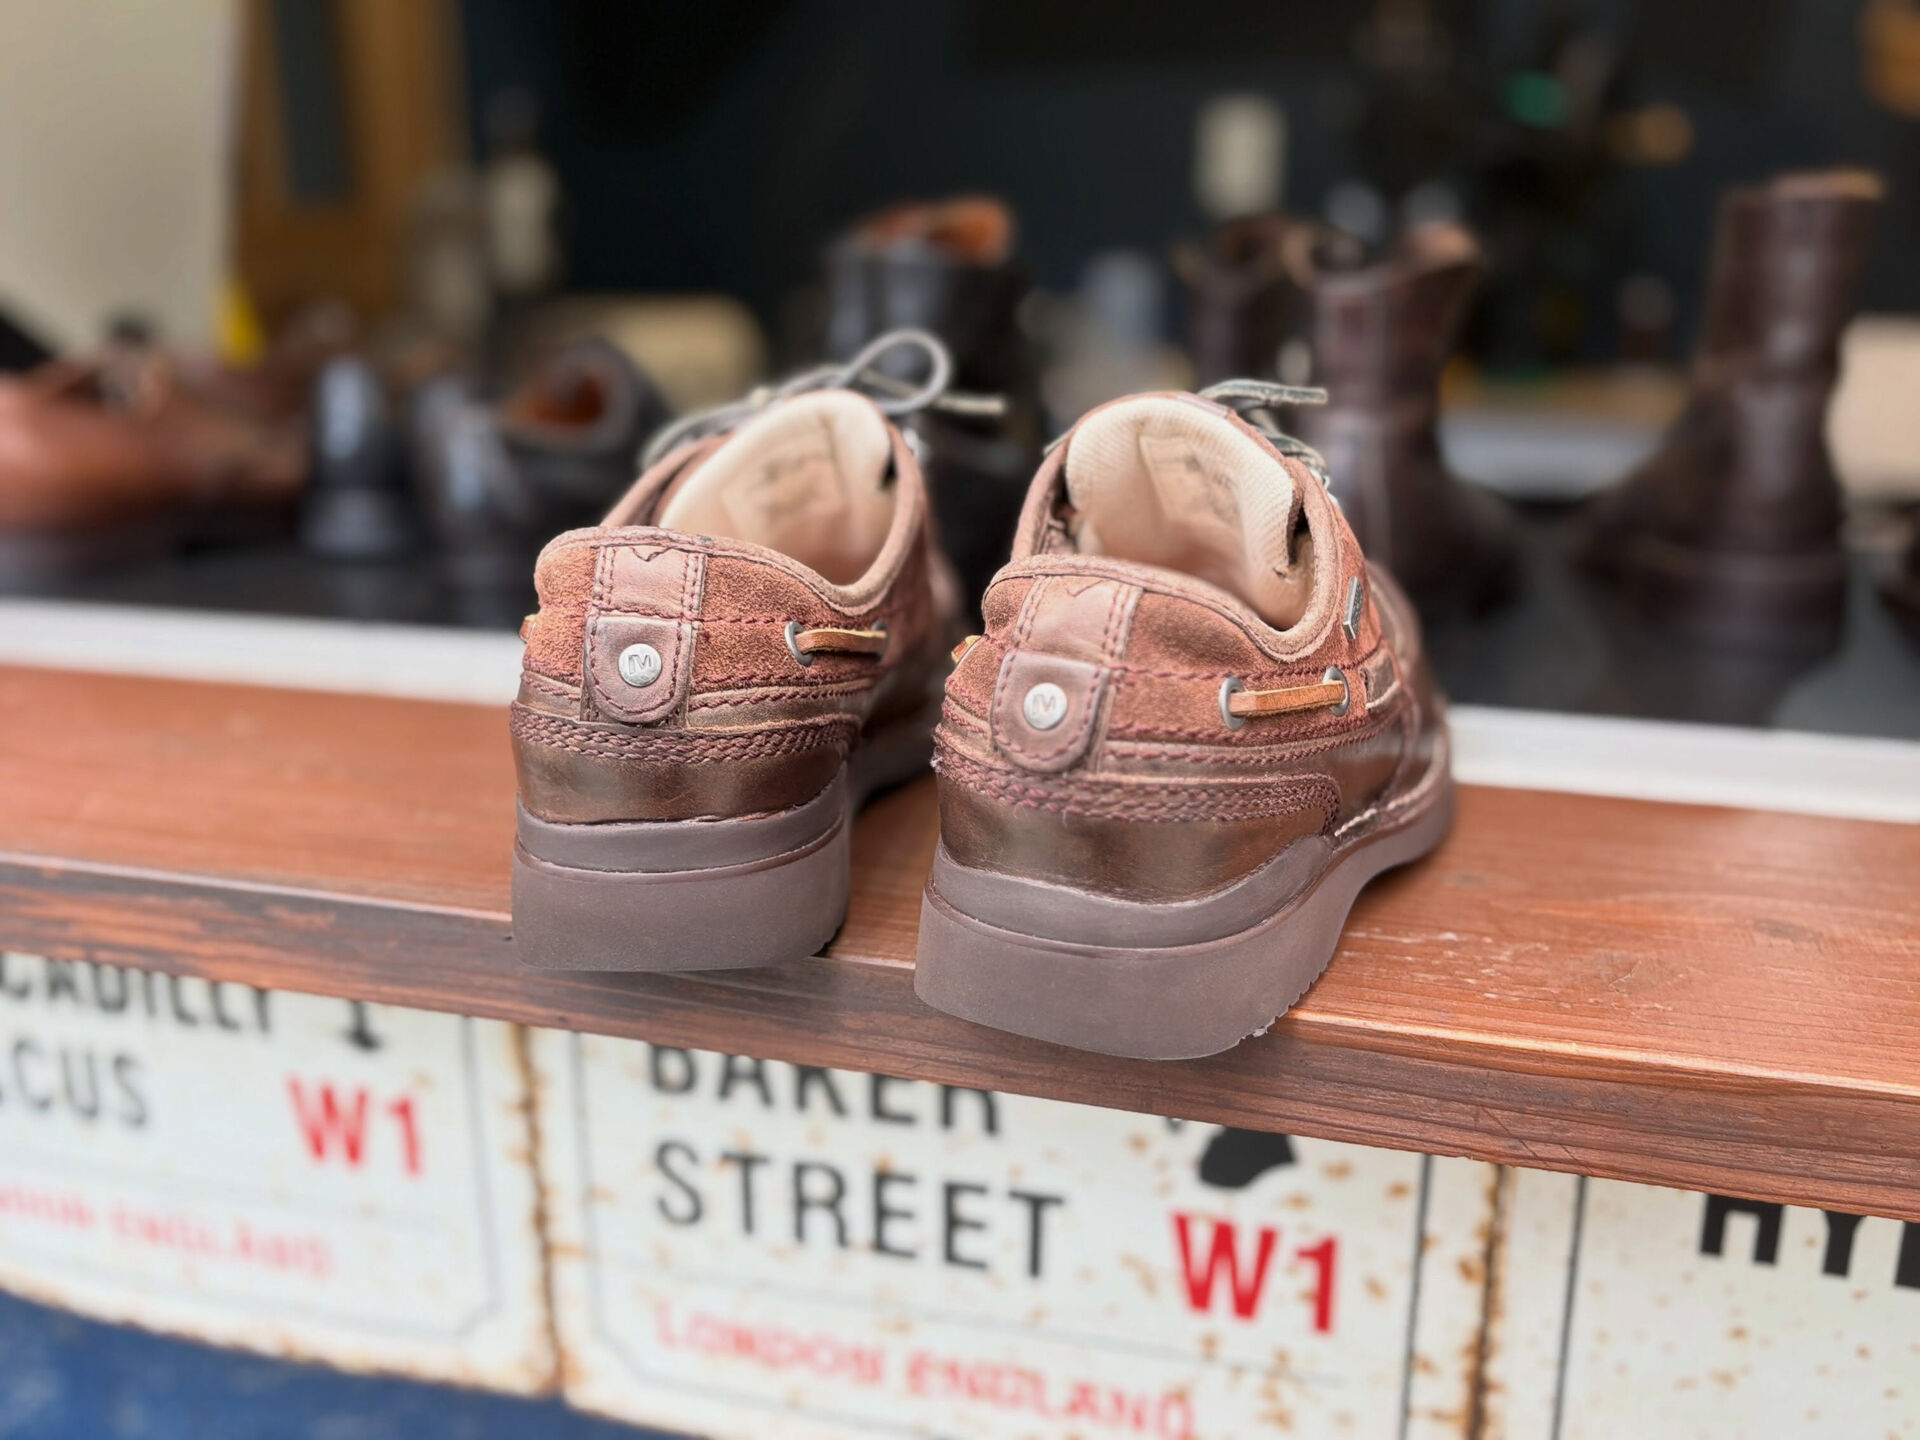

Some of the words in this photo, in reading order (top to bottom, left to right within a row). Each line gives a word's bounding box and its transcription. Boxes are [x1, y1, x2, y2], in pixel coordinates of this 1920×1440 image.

[0, 1038, 148, 1127] CUS
[286, 1071, 421, 1178] W1
[654, 1140, 1066, 1280] STREET
[1698, 1193, 1920, 1290] HY
[1172, 1209, 1340, 1336] W1
[652, 1300, 886, 1384] LONDON
[905, 1348, 1197, 1440] ENGLAND
